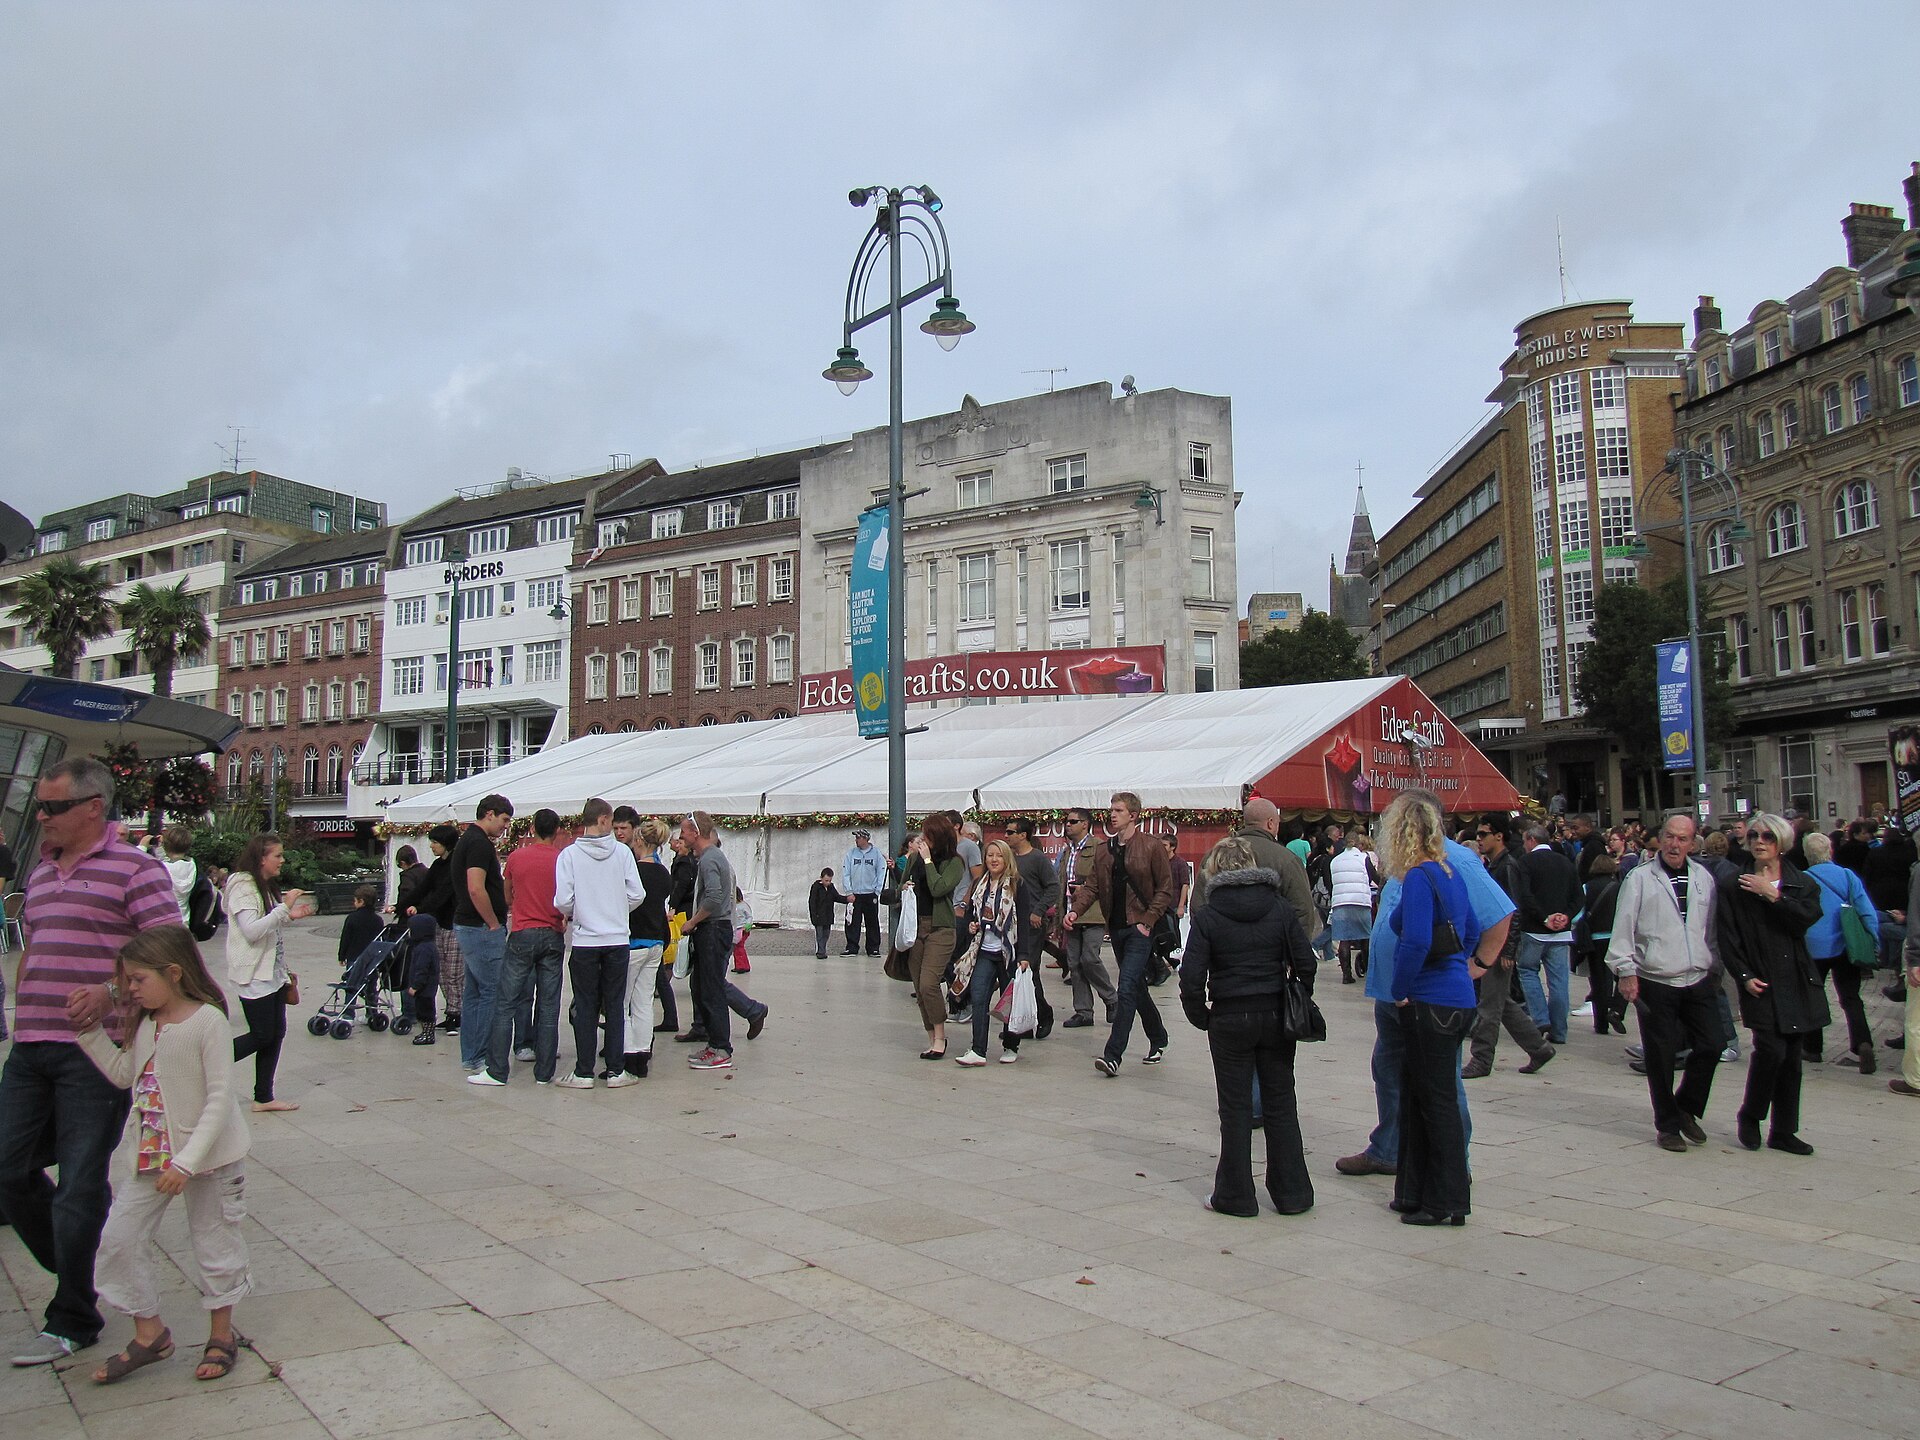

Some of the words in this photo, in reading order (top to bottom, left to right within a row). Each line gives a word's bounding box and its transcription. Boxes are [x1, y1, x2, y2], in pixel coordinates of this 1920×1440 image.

[1565, 329, 1576, 342] &
[1580, 324, 1626, 339] WEST
[1536, 344, 1589, 368] HOUSE
[444, 561, 504, 584] BORDERS
[862, 589, 871, 599] NOT
[871, 589, 875, 597] A
[852, 614, 877, 626] EXPLORER
[853, 626, 858, 635] OF
[801, 656, 1058, 708] Ederafts.co.uk
[73, 699, 96, 708] CANCER
[1381, 706, 1409, 742] Eder
[1374, 747, 1396, 768] Quality
[1428, 752, 1439, 767] Gift
[1442, 752, 1452, 767] Fair
[1370, 770, 1384, 787] The
